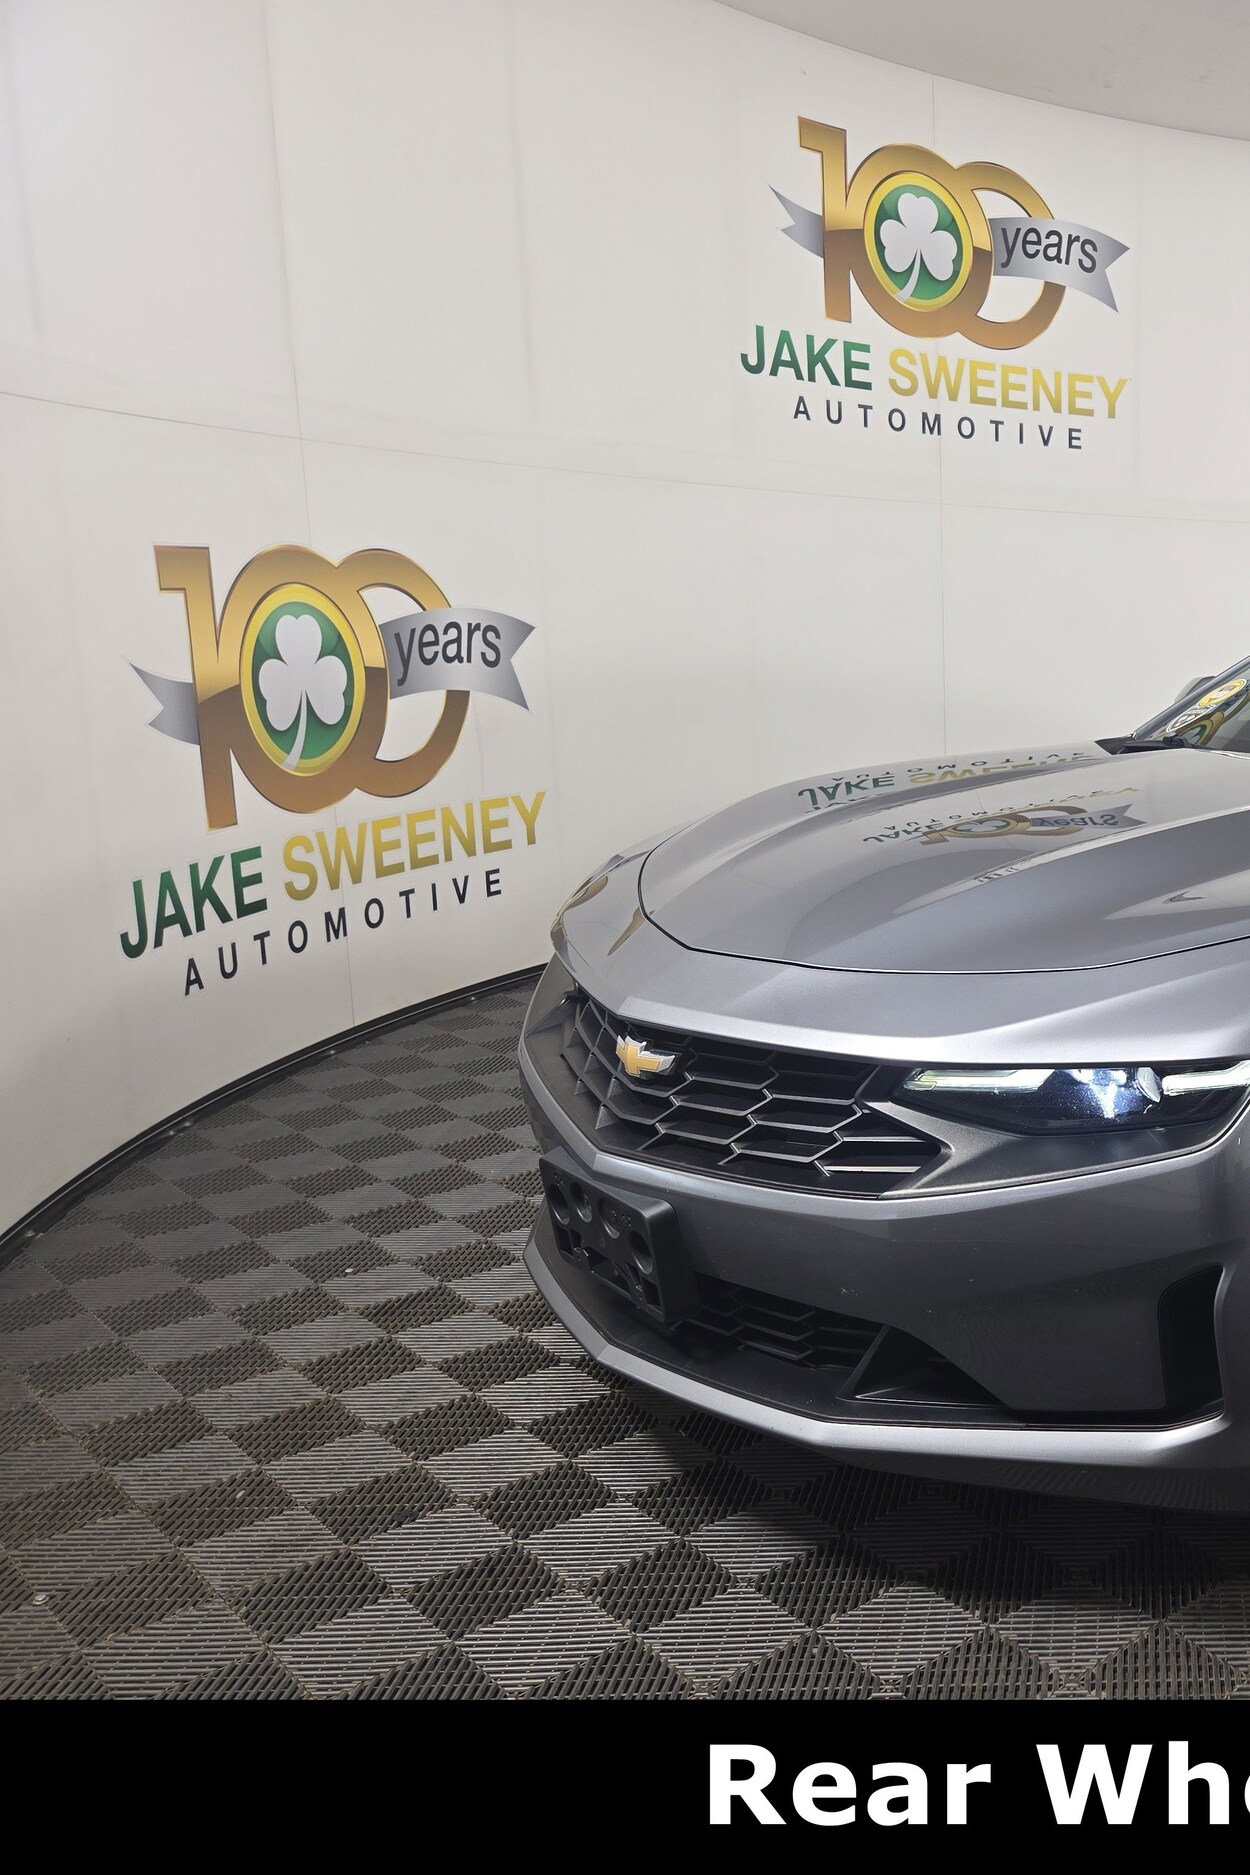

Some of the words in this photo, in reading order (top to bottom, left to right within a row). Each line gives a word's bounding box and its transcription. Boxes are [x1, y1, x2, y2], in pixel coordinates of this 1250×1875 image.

[797, 116, 1066, 350] 100
[1001, 226, 1098, 274] years
[740, 325, 872, 391] JAKE
[888, 348, 1128, 419] SWEENEY
[793, 396, 1082, 449] AUTOMOTIVE
[154, 545, 470, 831] 100
[394, 621, 501, 686] years
[120, 846, 267, 958] JAKE
[283, 791, 546, 901] SWEENEY
[185, 868, 501, 995] AUTOMOTIVE
